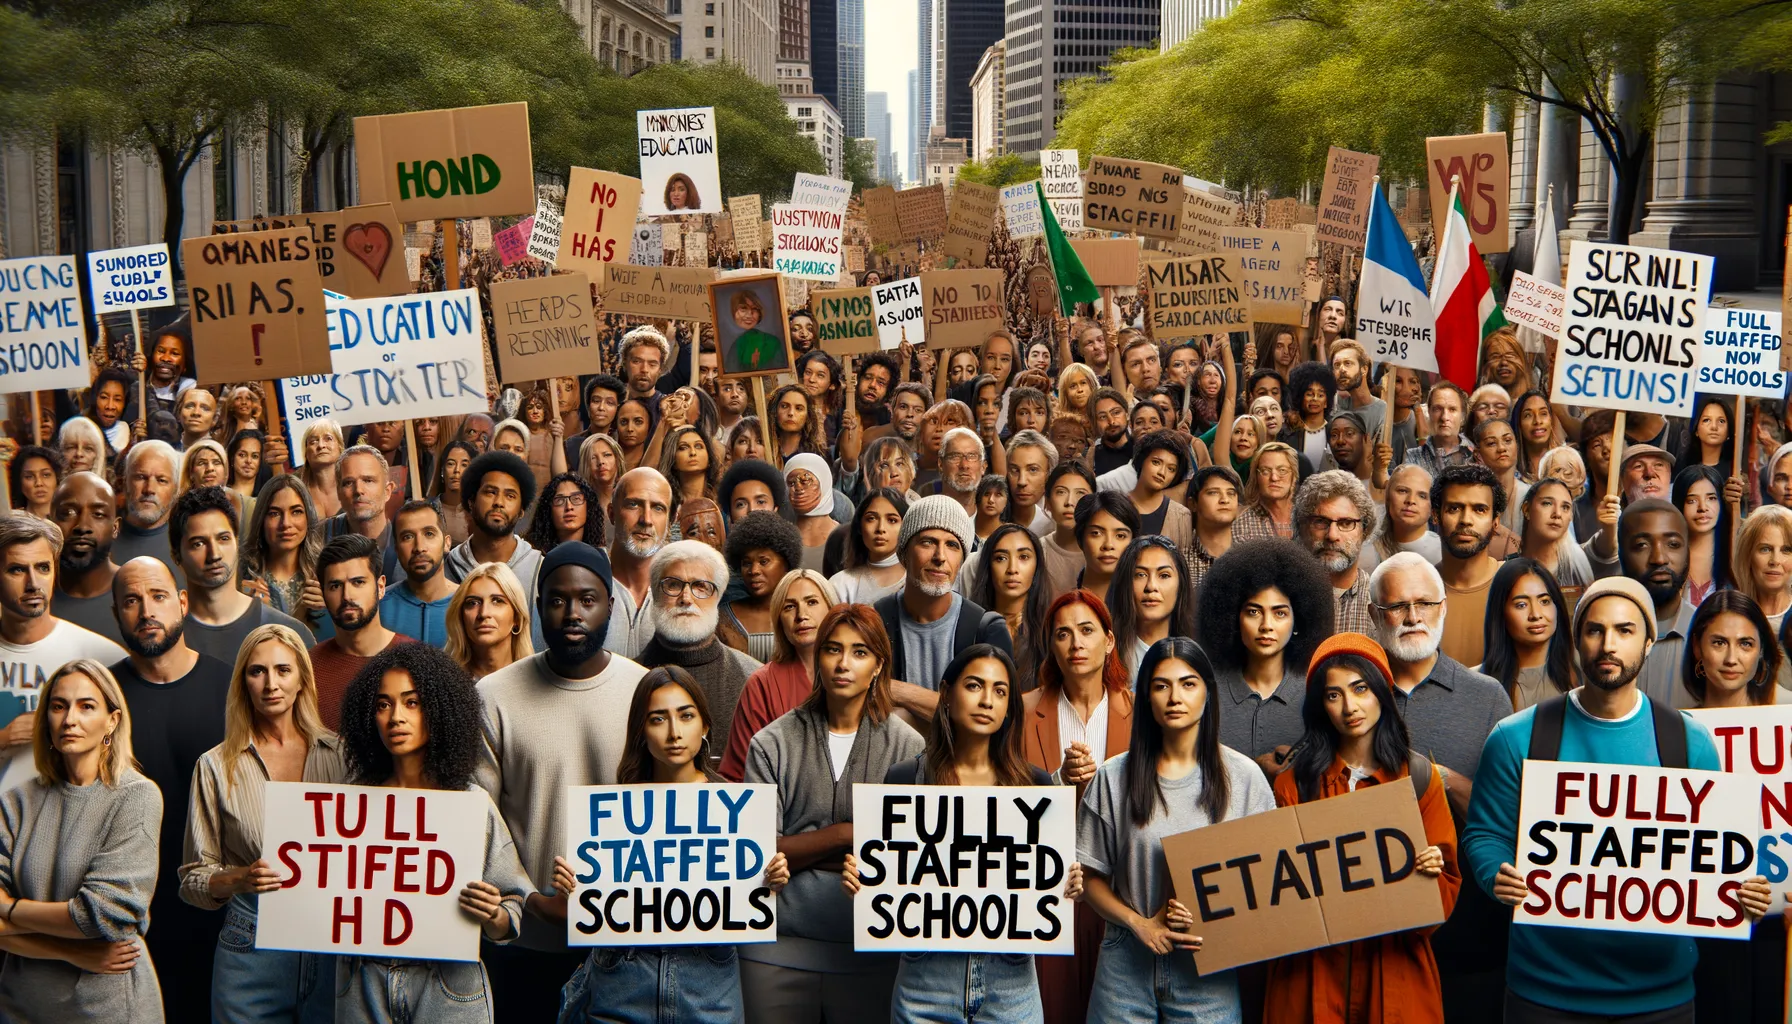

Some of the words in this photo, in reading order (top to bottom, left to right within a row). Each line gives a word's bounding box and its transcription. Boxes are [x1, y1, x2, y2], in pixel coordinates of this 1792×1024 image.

[396, 153, 502, 201] HOND
[590, 181, 618, 209] NO
[595, 208, 604, 233] I
[572, 232, 617, 262] HAS
[933, 286, 958, 307] NO
[1726, 310, 1772, 331] FULL
[1564, 324, 1697, 369] SCHONLS
[1725, 350, 1762, 366] NOW
[1560, 363, 1689, 409] SETUNS!
[1698, 366, 1783, 389] SCHOOLS
[1714, 725, 1792, 775] TU
[588, 788, 755, 837] FULLY
[880, 794, 1052, 845] FULLY
[1554, 771, 1716, 824] FULLY
[276, 840, 456, 896] STIFED
[575, 838, 764, 885] STAFFED
[859, 839, 1065, 891] STAFFED
[1527, 820, 1754, 875] STAFFED
[1191, 827, 1417, 923] ETATED
[1523, 868, 1746, 928] SCHOOLS
[575, 886, 775, 935] SCHOOLS
[866, 892, 1062, 941] SCHOOLS
